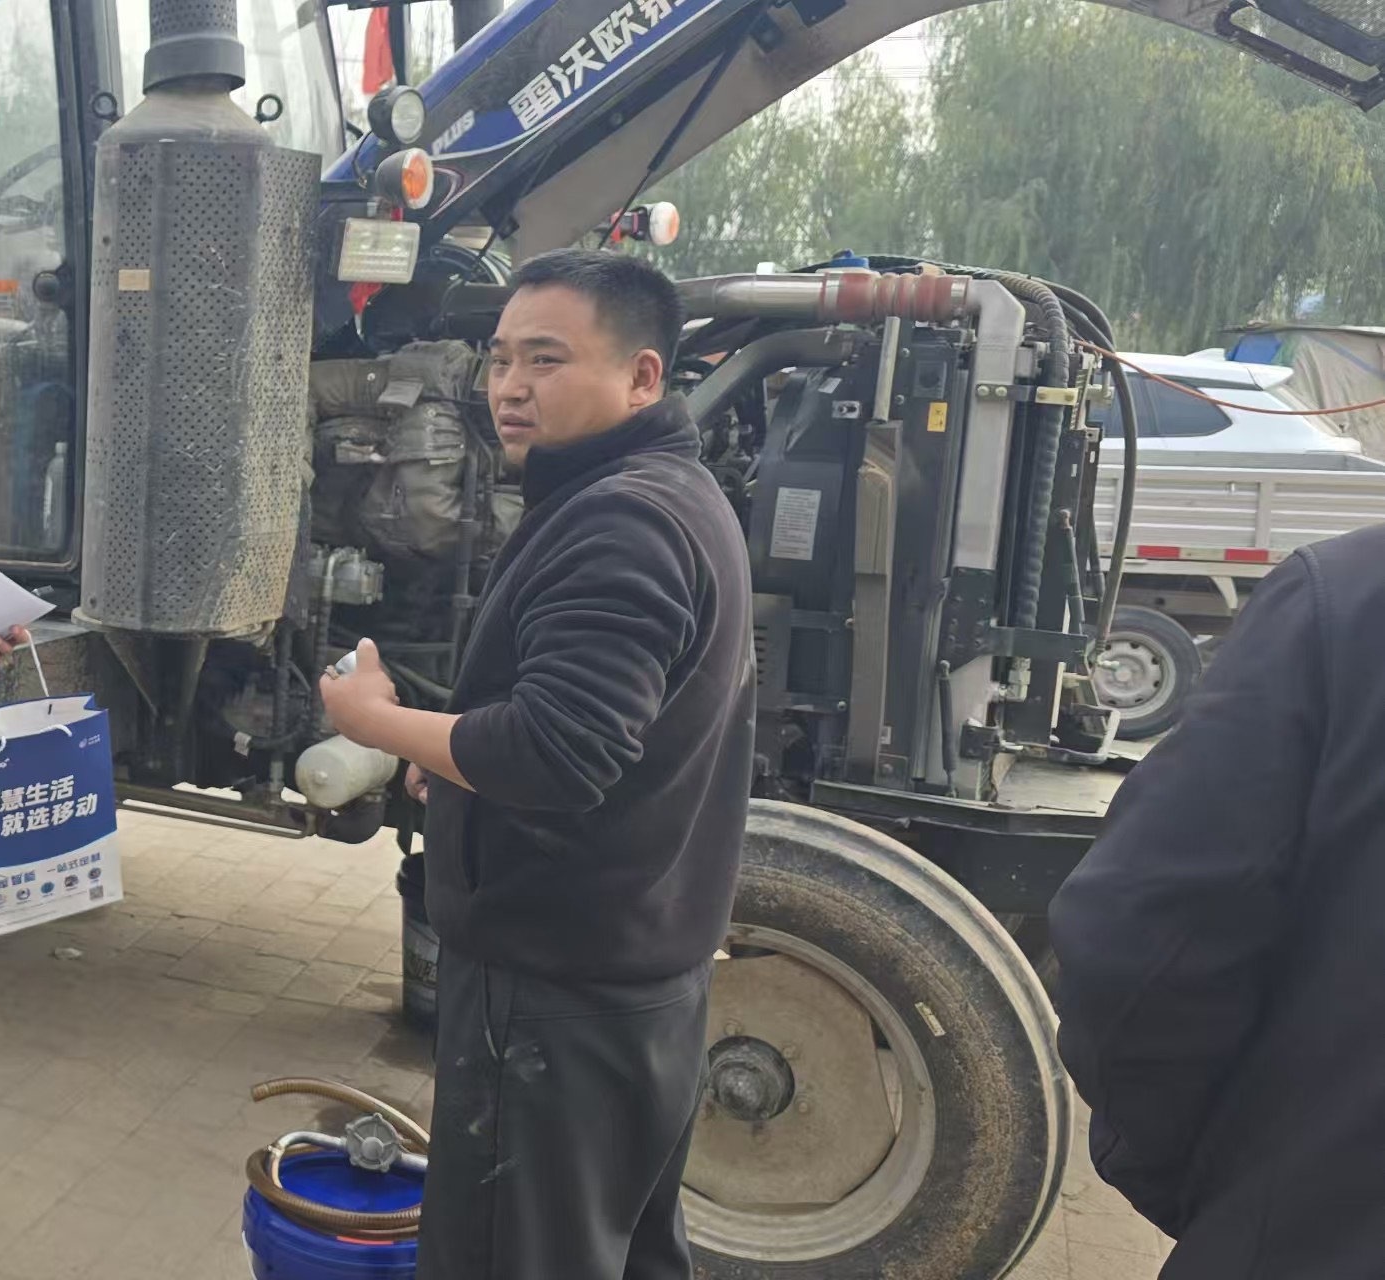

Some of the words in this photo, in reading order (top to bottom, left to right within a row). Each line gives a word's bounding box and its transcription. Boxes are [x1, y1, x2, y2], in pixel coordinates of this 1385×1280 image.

[431, 109, 476, 156] PLUS
[0, 793, 99, 837] 就选移动
